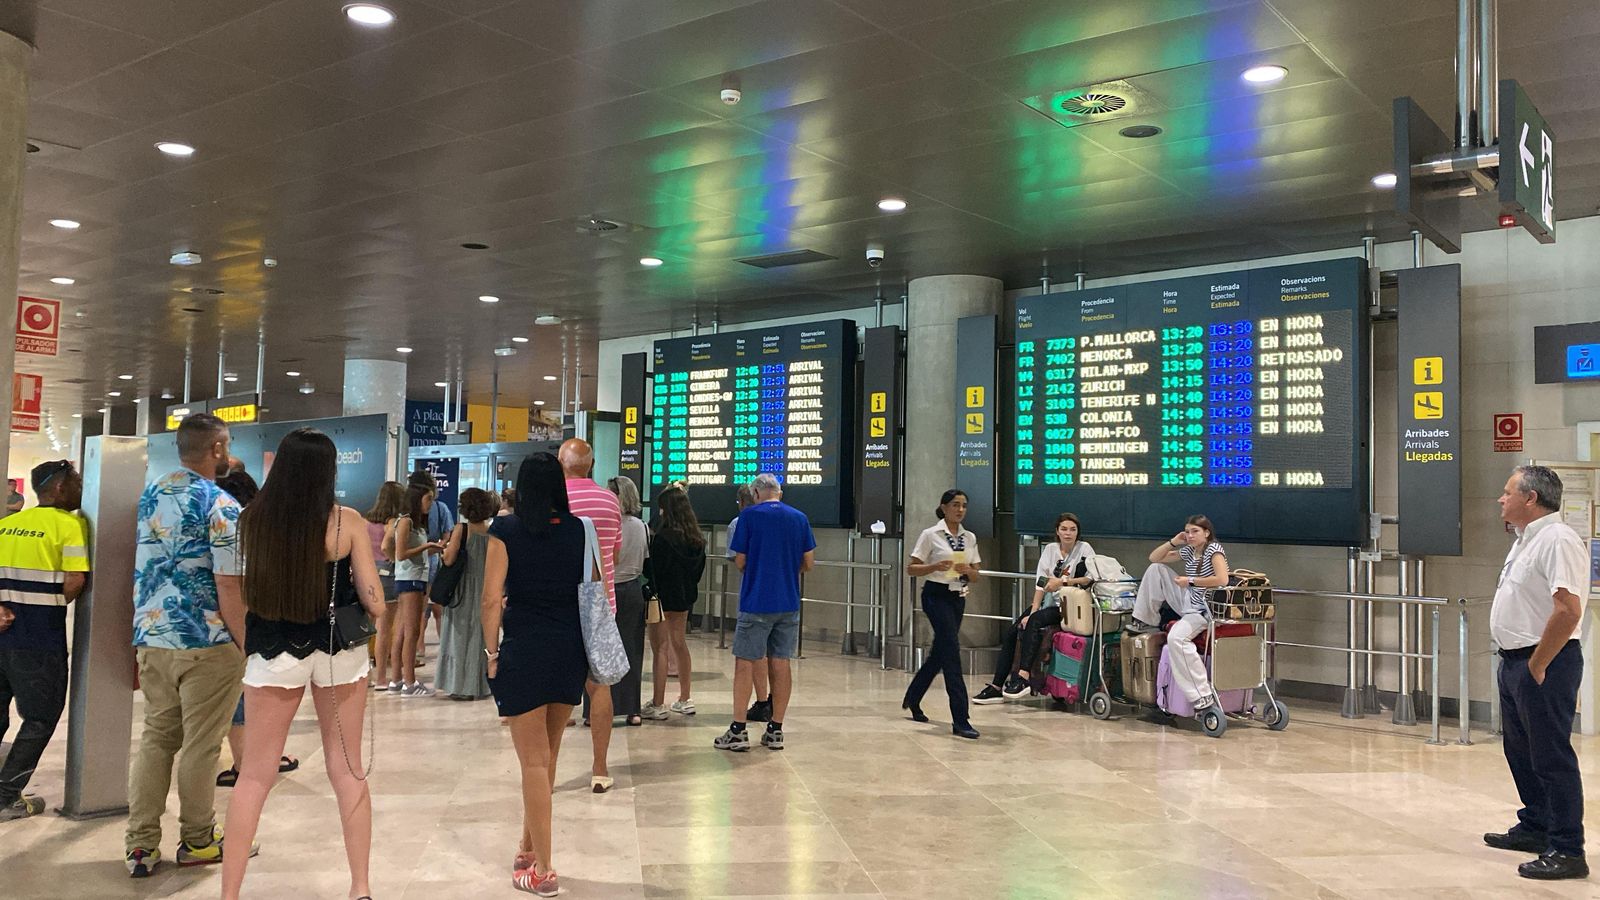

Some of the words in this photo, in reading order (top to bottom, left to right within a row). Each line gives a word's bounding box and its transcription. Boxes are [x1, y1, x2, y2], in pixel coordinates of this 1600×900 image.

[1281, 276, 1325, 286] Observacions
[1211, 283, 1240, 292] Estimada
[1281, 292, 1329, 302] Observaciones
[1211, 300, 1240, 309] Estimada
[1019, 342, 1034, 352] FR
[1046, 338, 1075, 350] 7373
[1081, 330, 1156, 347] P.MALLORCA
[1162, 326, 1203, 340] 13:20
[1260, 319, 1279, 332] EN
[1286, 315, 1324, 331] HORA
[17, 338, 55, 347] PULSADOR
[1019, 356, 1034, 367] FR
[1081, 348, 1133, 363] MENORCA
[1162, 343, 1203, 356] 13:20
[1260, 336, 1279, 349] EN
[1286, 333, 1324, 347] HORA
[690, 369, 728, 380] FRANKFURT
[789, 360, 823, 372] ARRIVAL
[1045, 368, 1075, 380] 6317
[1080, 362, 1149, 378] MILAN-MXP
[1162, 359, 1203, 372] 13:50
[1210, 356, 1252, 368] 14:20
[1260, 349, 1342, 366] RETRASADO
[789, 373, 823, 384] ARRIVAL
[1019, 386, 1033, 396] LX
[1045, 383, 1074, 395] 2142
[1080, 380, 1125, 393] ZURICH
[1162, 375, 1203, 388] 14:15
[1210, 373, 1252, 385] 14:20
[1260, 370, 1279, 383] EN
[1286, 368, 1324, 382] HORA
[789, 386, 823, 396] ARRIVAL
[1081, 395, 1140, 408] TENERIFE
[1146, 394, 1156, 405] N
[1162, 392, 1203, 405] 14:40
[1210, 390, 1252, 402] 14:20
[1260, 387, 1279, 400] EN
[1286, 385, 1324, 399] HORA
[689, 404, 720, 414] SEVILLA
[788, 398, 823, 409] ARRIVAL
[413, 409, 420, 419] A
[424, 409, 443, 423] plac
[788, 411, 823, 421] ARRIVAL
[1080, 411, 1133, 423] COLONIA
[1162, 408, 1203, 420] 14:40
[1210, 406, 1252, 418] 14:50
[1260, 404, 1279, 417] EN
[1286, 402, 1324, 416] HORA
[413, 421, 428, 433] for
[689, 428, 723, 438] TENERIFE
[788, 424, 822, 434] ARRIVAL
[1080, 426, 1140, 439] ROMA-FCO
[1162, 424, 1203, 436] 14:40
[1210, 423, 1252, 435] 14:45
[1260, 422, 1279, 434] EN
[1286, 420, 1324, 433] HORA
[1405, 429, 1449, 438] Arribades
[413, 438, 445, 447] mome
[689, 439, 728, 449] AMSTERDAM
[788, 437, 822, 446] DELAYED
[1018, 444, 1033, 455] FR
[1080, 442, 1148, 454] MEMMINGEN
[1162, 441, 1203, 452] 14:45
[1210, 439, 1252, 451] 14:45
[1405, 440, 1439, 449] Arrivals
[688, 451, 731, 460] PARIS-ORLY
[788, 449, 822, 459] ARRIVAL
[1406, 452, 1453, 463] Llegadas
[787, 462, 822, 471] ARRIVAL
[1018, 459, 1033, 469] FR
[1080, 458, 1125, 469] TANGER
[1162, 457, 1203, 468] 14:55
[688, 475, 726, 484] STUTTGART
[787, 475, 822, 484] DELAYED
[1080, 474, 1148, 485] EINDHOVEN
[1162, 473, 1203, 485] 15:05
[1260, 473, 1279, 485] EN
[1286, 472, 1324, 485] HORA
